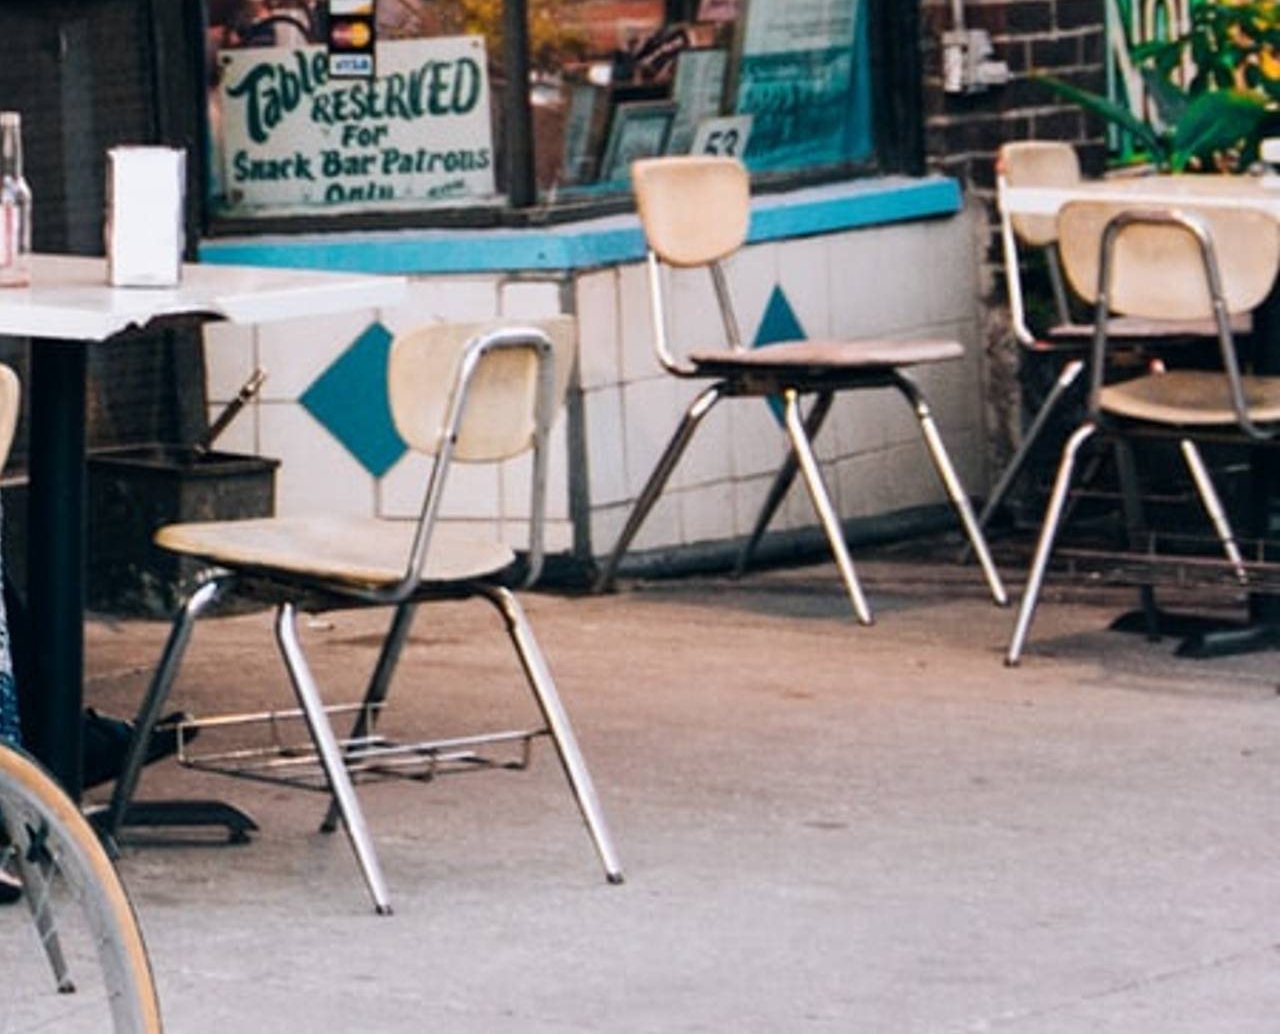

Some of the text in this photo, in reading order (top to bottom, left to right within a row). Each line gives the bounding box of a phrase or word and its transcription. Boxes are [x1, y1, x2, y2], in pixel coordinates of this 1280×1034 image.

[341, 123, 389, 147] For
[233, 145, 491, 182] Snack Bar Patrons
